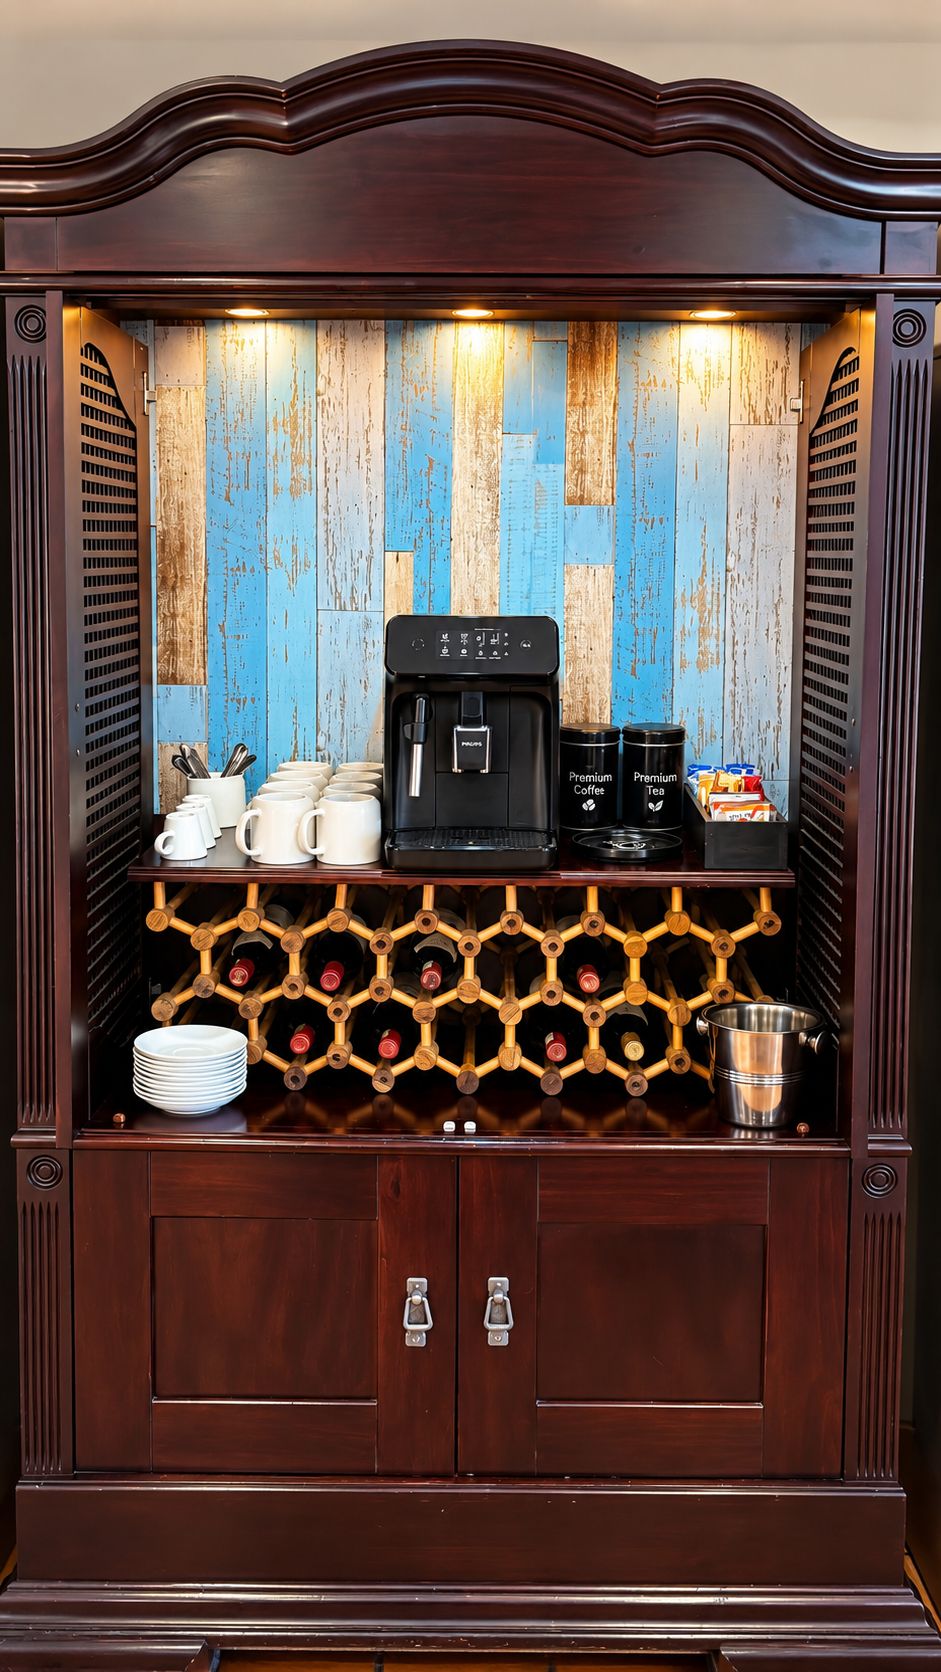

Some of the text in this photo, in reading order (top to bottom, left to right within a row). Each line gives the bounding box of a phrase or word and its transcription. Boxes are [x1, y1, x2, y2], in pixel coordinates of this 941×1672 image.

[569, 772, 612, 783] Premium
[634, 772, 678, 783] Premium
[574, 785, 605, 795] Coffee
[647, 785, 665, 796] Tea
